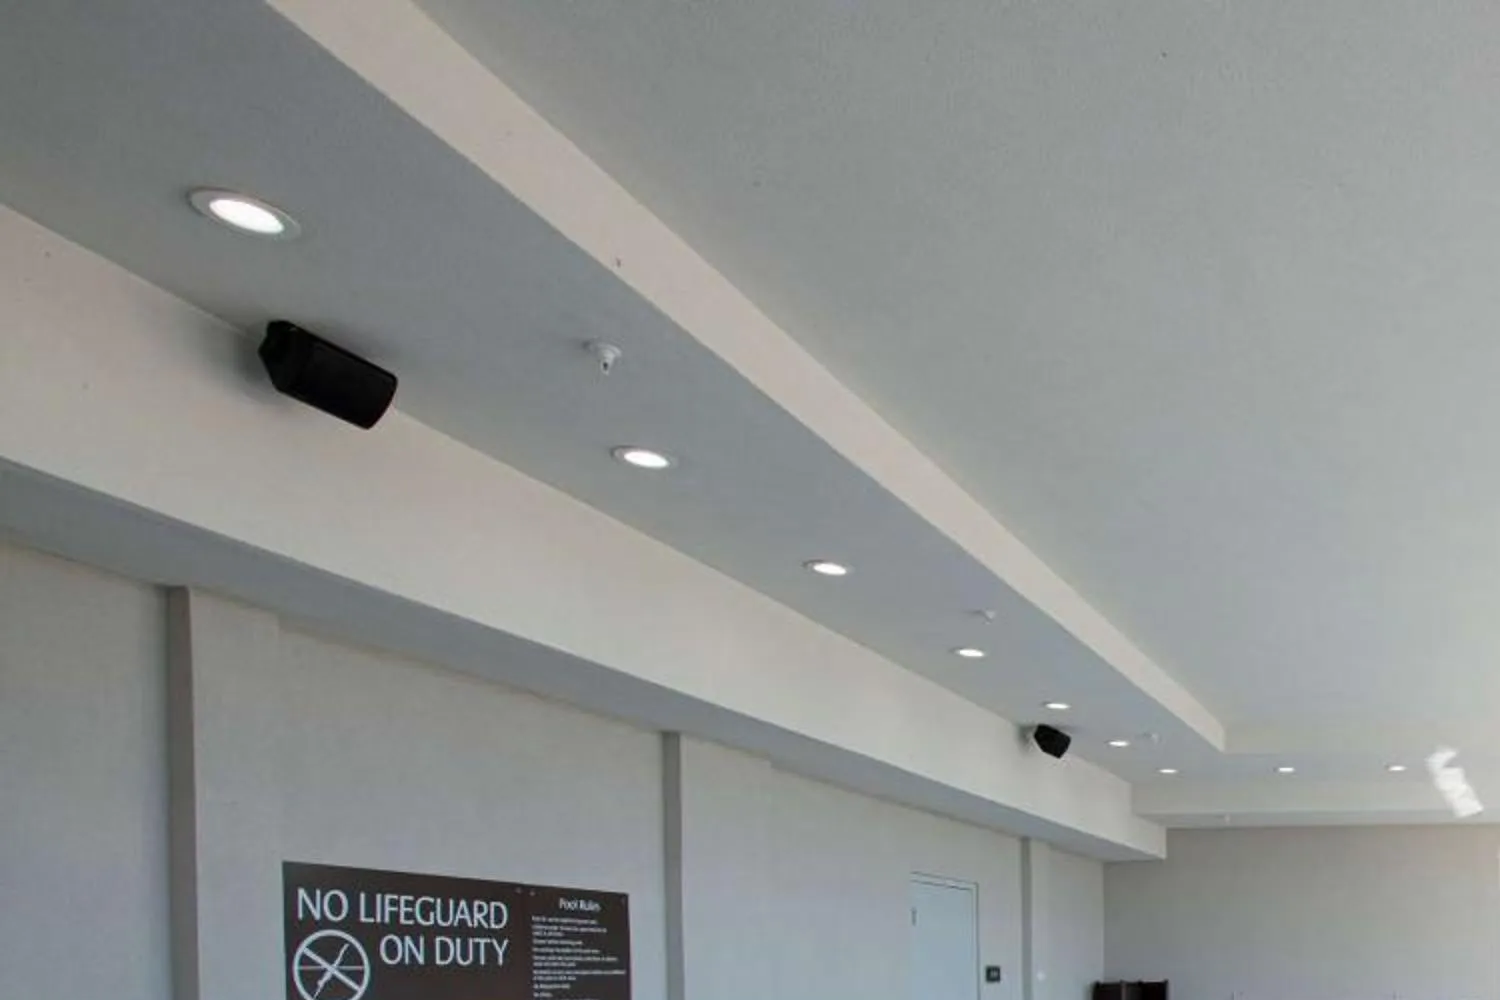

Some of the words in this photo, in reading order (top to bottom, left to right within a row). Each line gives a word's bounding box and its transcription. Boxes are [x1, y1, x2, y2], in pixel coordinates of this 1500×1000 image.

[297, 887, 348, 921] NO
[359, 891, 508, 929] LIFEGUARD
[559, 898, 578, 911] Pool
[379, 934, 425, 966] ON
[435, 936, 509, 966] DUTY
